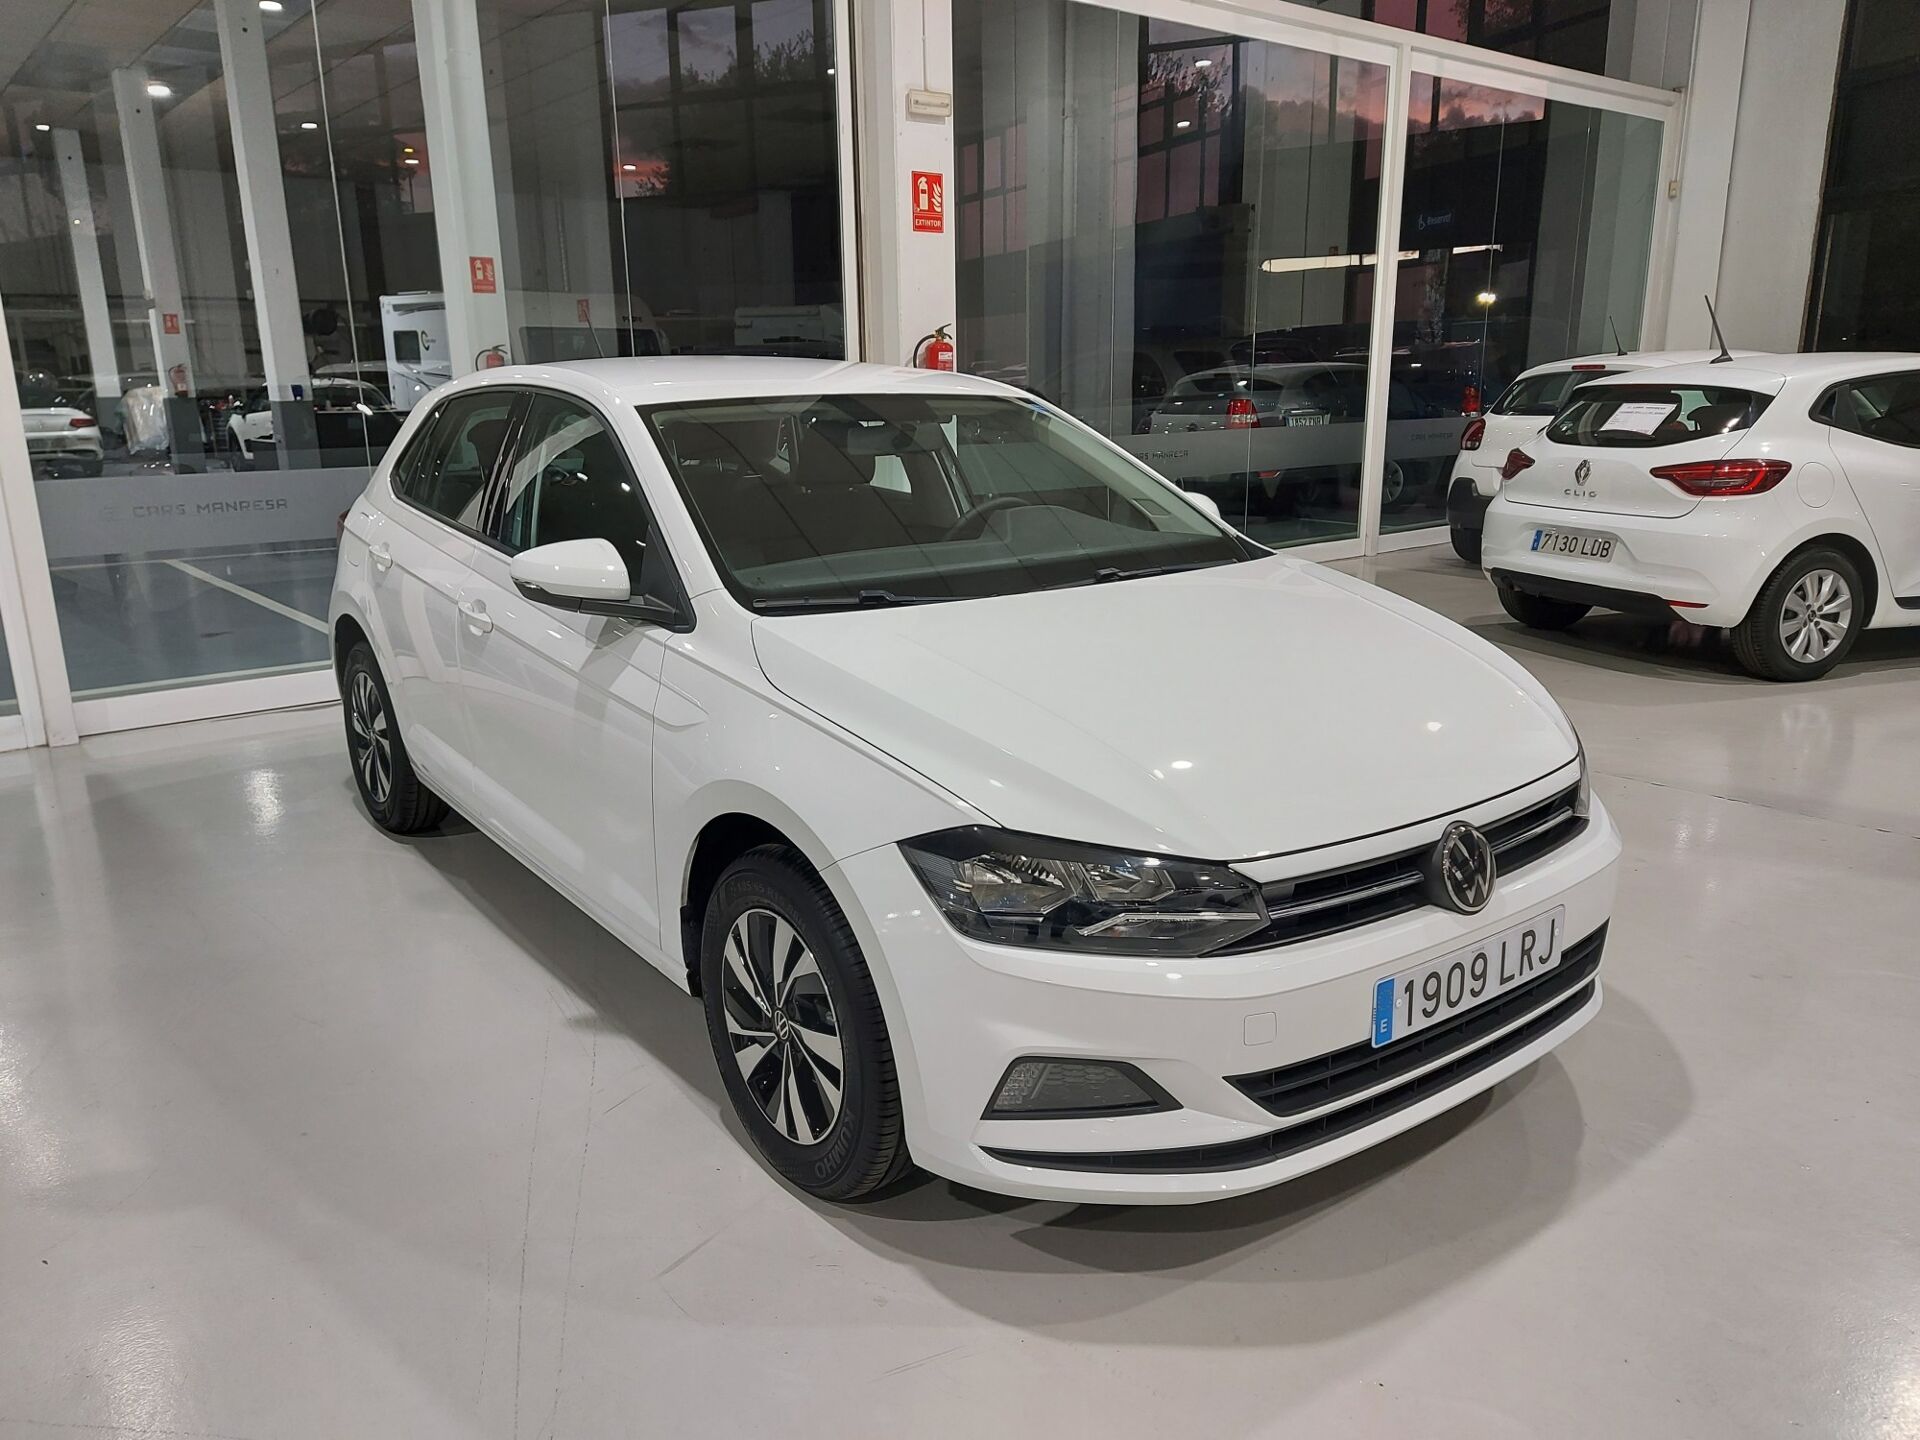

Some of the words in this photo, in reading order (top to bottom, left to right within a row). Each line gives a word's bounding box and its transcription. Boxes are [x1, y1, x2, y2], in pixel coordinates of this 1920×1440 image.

[915, 218, 942, 228] EXTINTOR
[1563, 488, 1598, 498] CLIO
[132, 503, 186, 518] CARS
[196, 498, 289, 515] MANRESA
[1541, 532, 1579, 554] 7130
[1580, 537, 1612, 558] LDB
[1404, 952, 1489, 1027] 1909
[1500, 918, 1556, 986] LRJ
[1380, 1017, 1388, 1033] E
[814, 1107, 857, 1179] KUMHO
